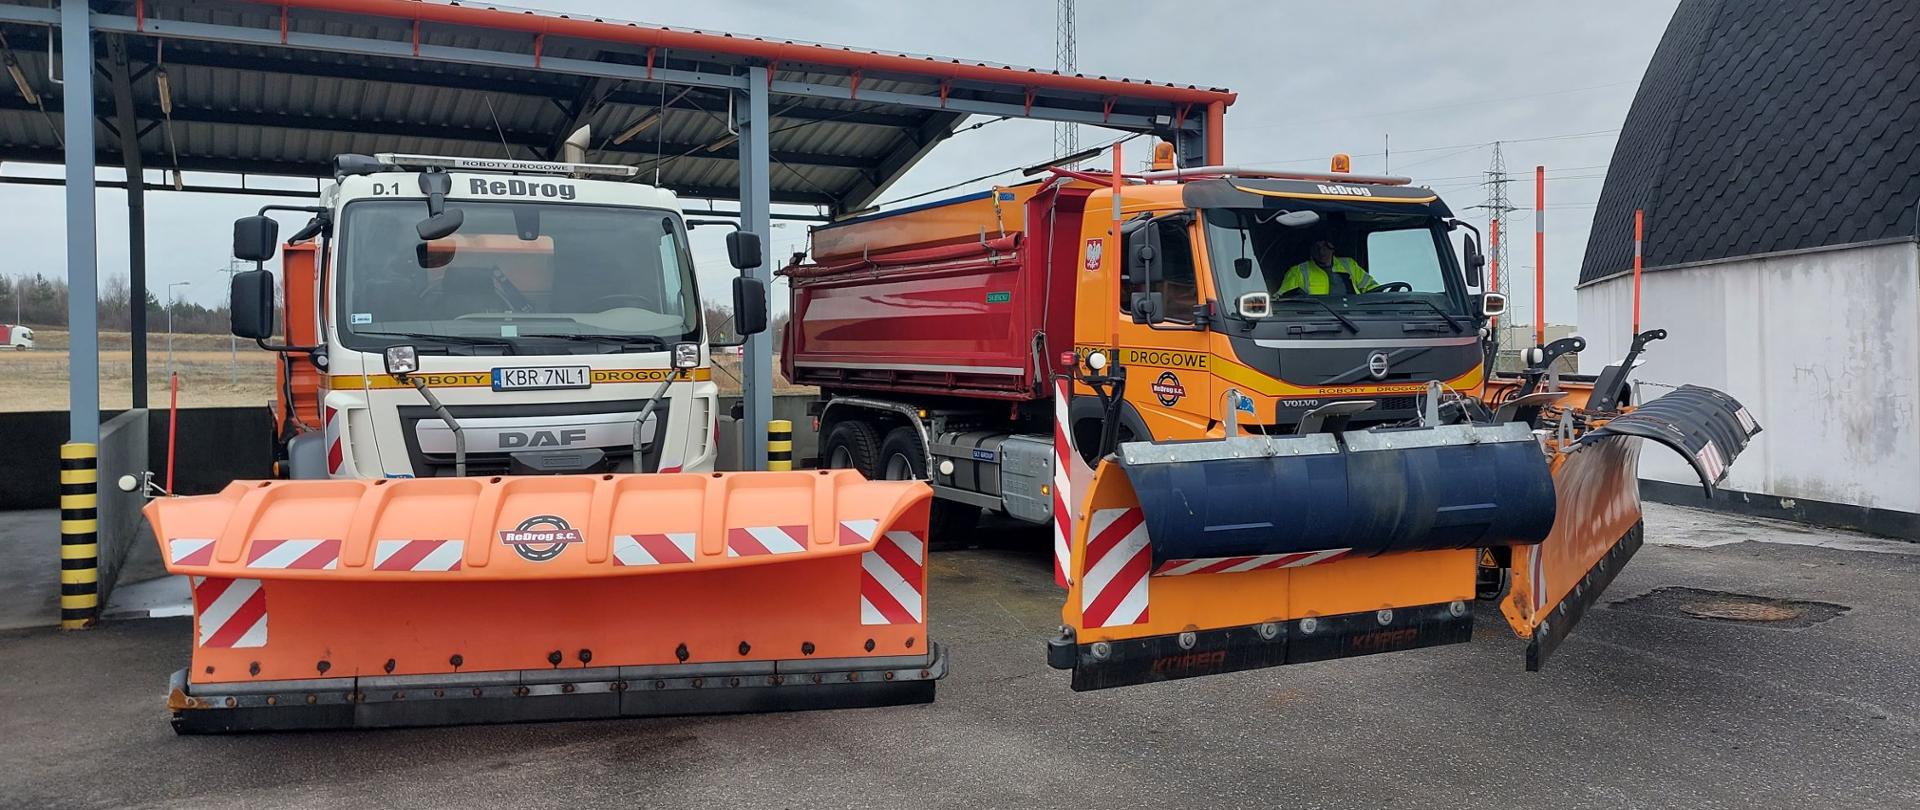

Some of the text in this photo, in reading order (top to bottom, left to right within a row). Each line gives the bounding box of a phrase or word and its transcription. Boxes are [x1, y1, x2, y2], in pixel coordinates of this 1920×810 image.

[512, 163, 569, 171] DROGOWE
[373, 182, 399, 196] D.1
[469, 178, 576, 200] ReDrog
[1317, 184, 1372, 197] ReDrog
[1130, 350, 1207, 368] DROGOWE
[505, 368, 584, 386] KBR 7NL1
[499, 429, 586, 448] DAF
[506, 532, 577, 541] ReDrog s.c.
